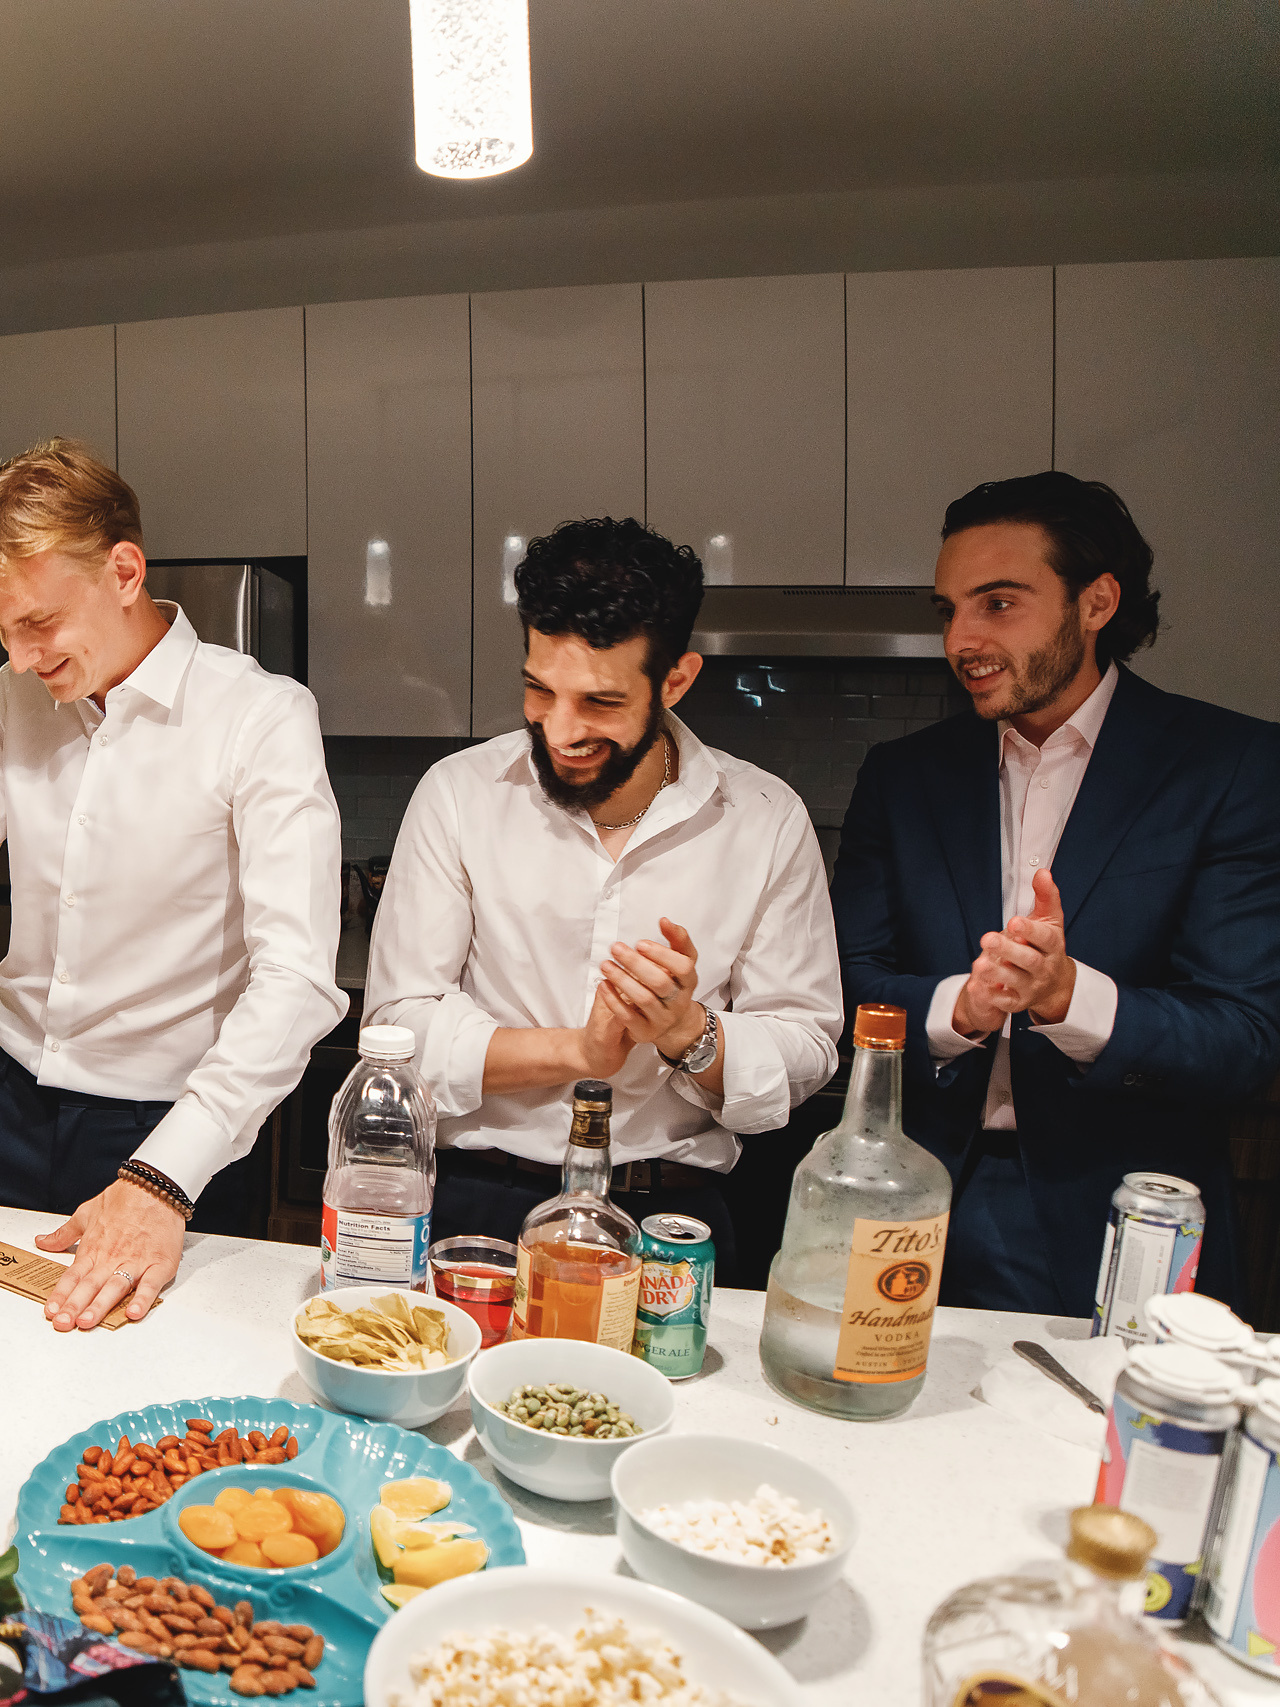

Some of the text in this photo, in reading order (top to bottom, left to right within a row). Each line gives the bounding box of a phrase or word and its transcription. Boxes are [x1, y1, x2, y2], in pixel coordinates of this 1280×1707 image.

[338, 1219, 369, 1230] Nutrition
[371, 1224, 391, 1232] Facts
[870, 1223, 942, 1253] Tito's
[640, 1273, 696, 1290] ANADA
[643, 1290, 679, 1305] DRY
[874, 1331, 919, 1342] VODKA
[668, 1348, 690, 1357] ALE
